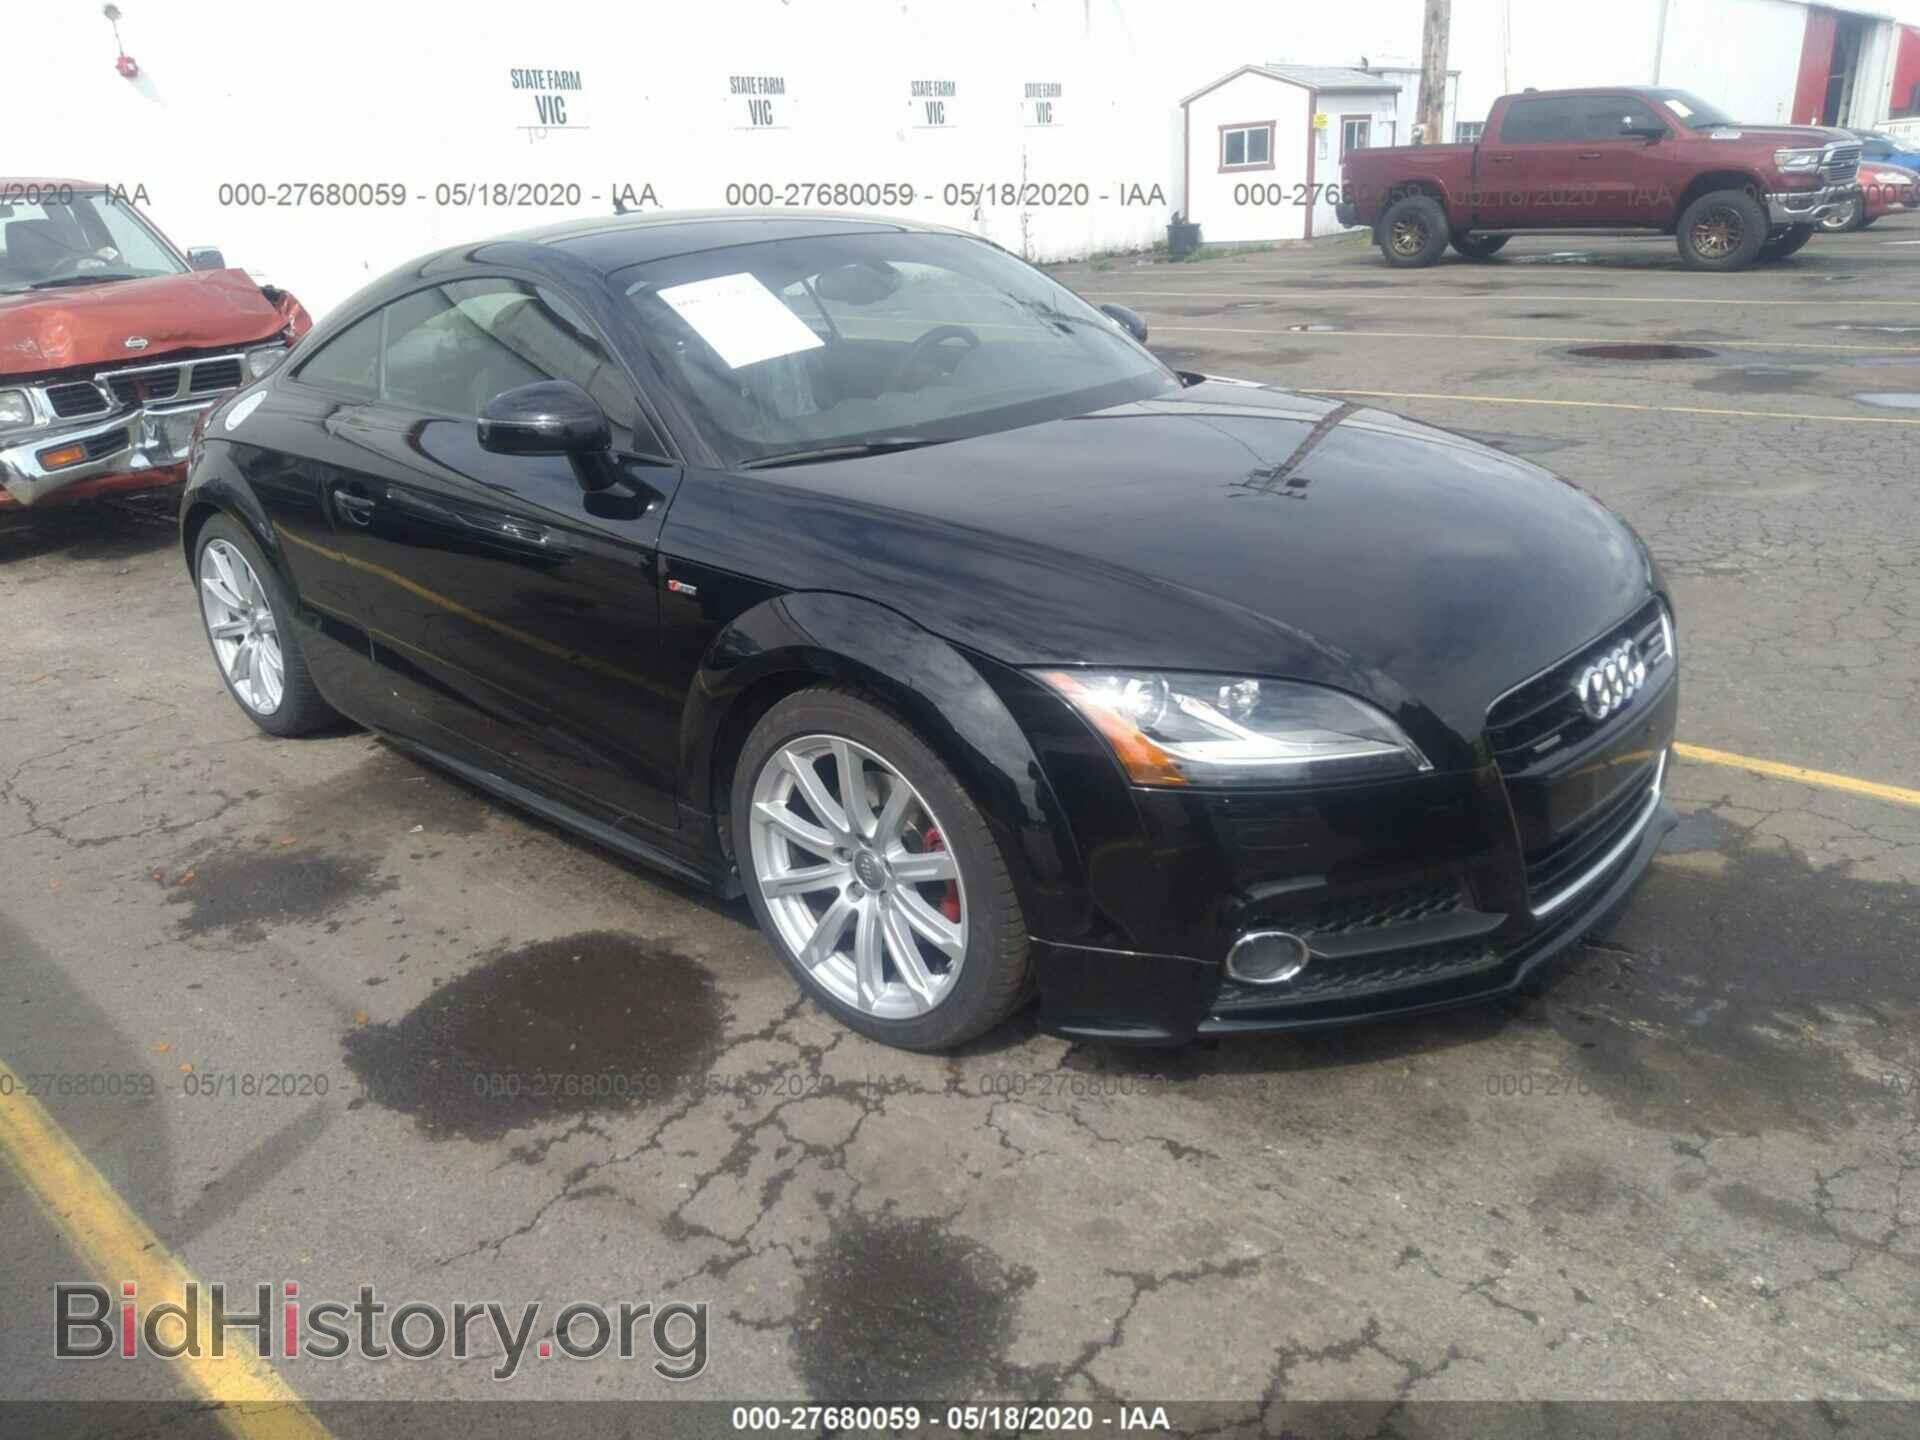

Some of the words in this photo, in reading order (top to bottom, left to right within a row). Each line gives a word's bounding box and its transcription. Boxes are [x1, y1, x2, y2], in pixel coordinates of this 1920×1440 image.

[511, 68, 546, 90] STATE
[547, 69, 582, 91] FARM
[730, 75, 757, 95] STATE
[758, 76, 785, 96] FARM
[911, 80, 933, 97] STATE
[934, 80, 956, 97] FARM
[1024, 83, 1042, 98] STATE
[1043, 83, 1062, 98] FARM
[535, 95, 567, 125] VIC
[748, 99, 773, 125] VIC
[925, 101, 945, 124] VIC
[1036, 102, 1053, 124] VIC
